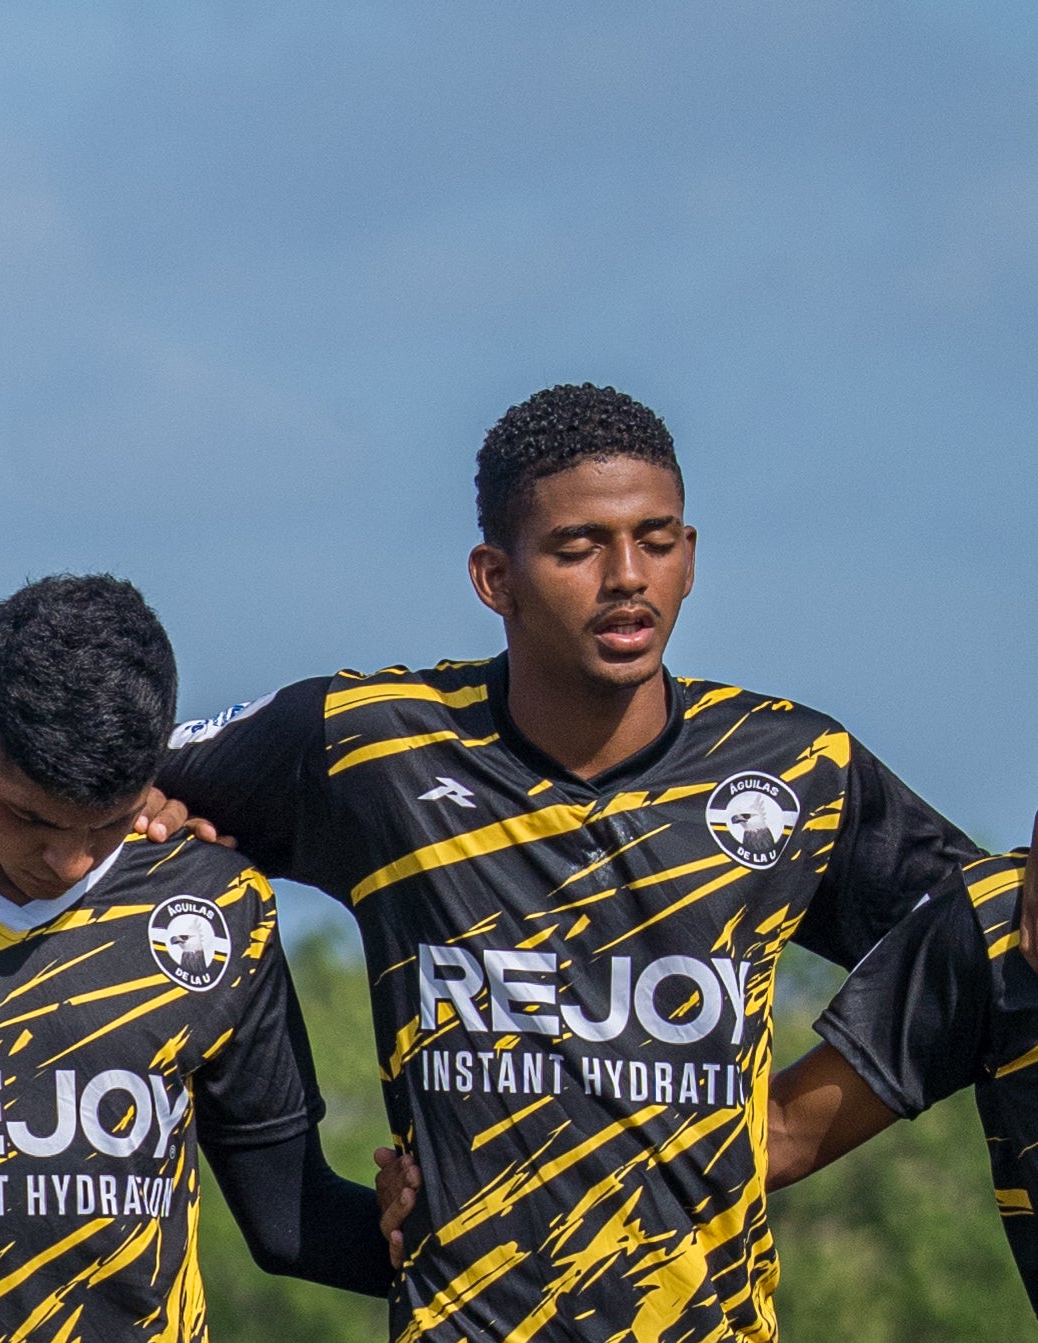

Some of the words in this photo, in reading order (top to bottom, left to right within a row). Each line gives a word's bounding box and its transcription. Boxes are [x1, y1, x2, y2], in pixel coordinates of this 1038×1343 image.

[737, 847, 750, 859] DE
[753, 854, 767, 862] LA
[769, 851, 776, 859] U
[175, 968, 189, 981] DE
[190, 975, 203, 985] LA
[203, 973, 210, 983] U
[418, 943, 751, 1046] REJOY
[422, 1049, 564, 1095] INSTANT
[581, 1056, 745, 1106] HYDRATI
